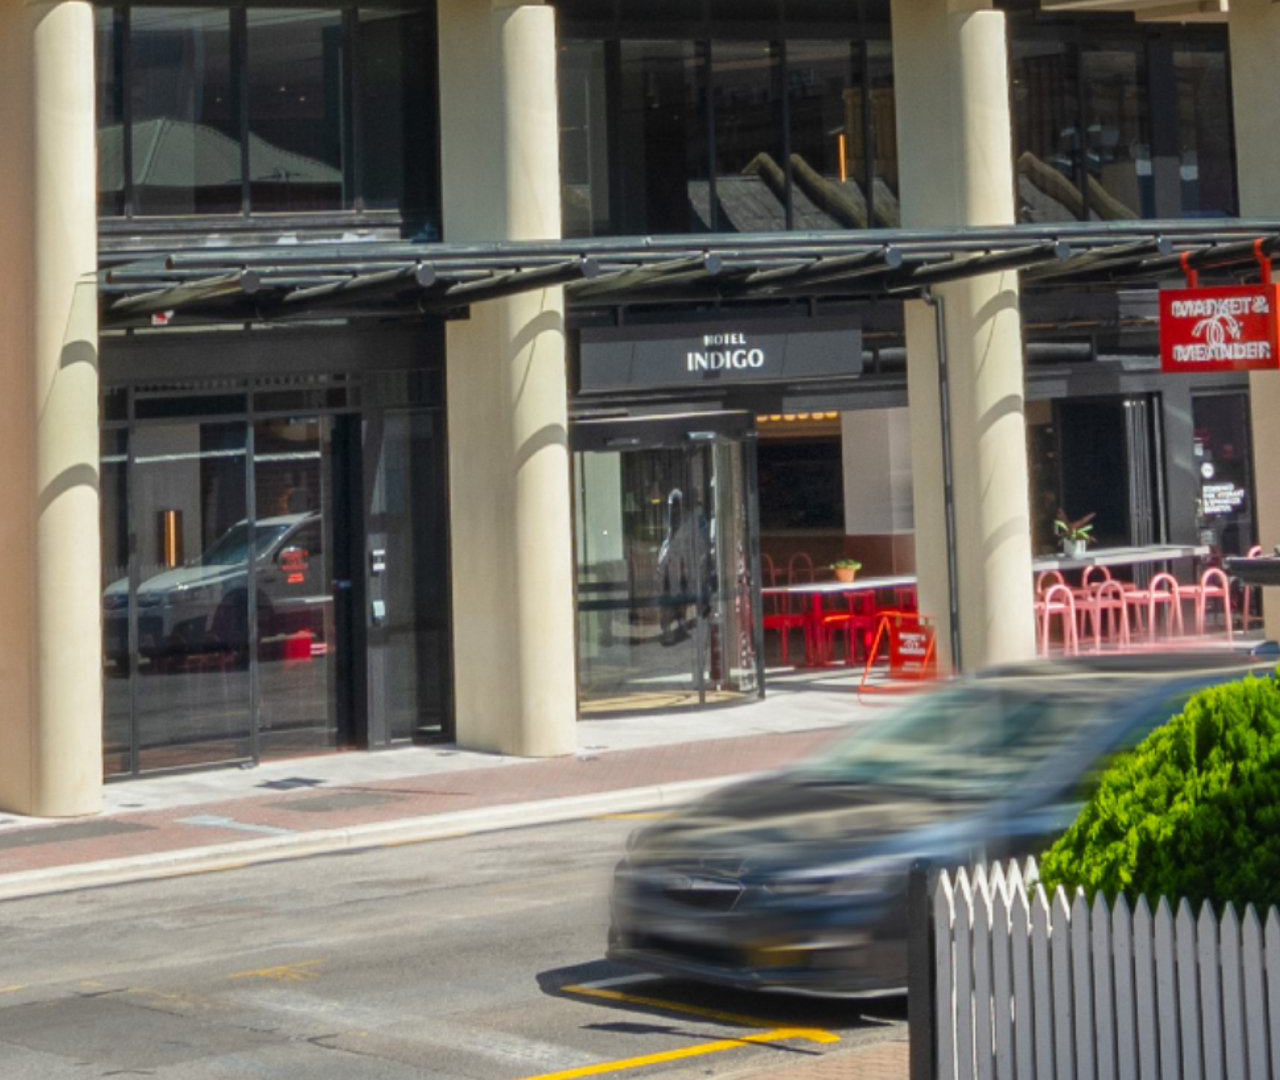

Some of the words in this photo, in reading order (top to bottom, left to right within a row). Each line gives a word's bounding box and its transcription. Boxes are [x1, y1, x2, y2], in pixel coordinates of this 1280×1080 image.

[1171, 297, 1251, 318] MARKET
[1252, 295, 1269, 314] &
[703, 332, 747, 347] HOTEL
[687, 348, 764, 371] INDIGO
[1172, 340, 1271, 362] MEANDER
